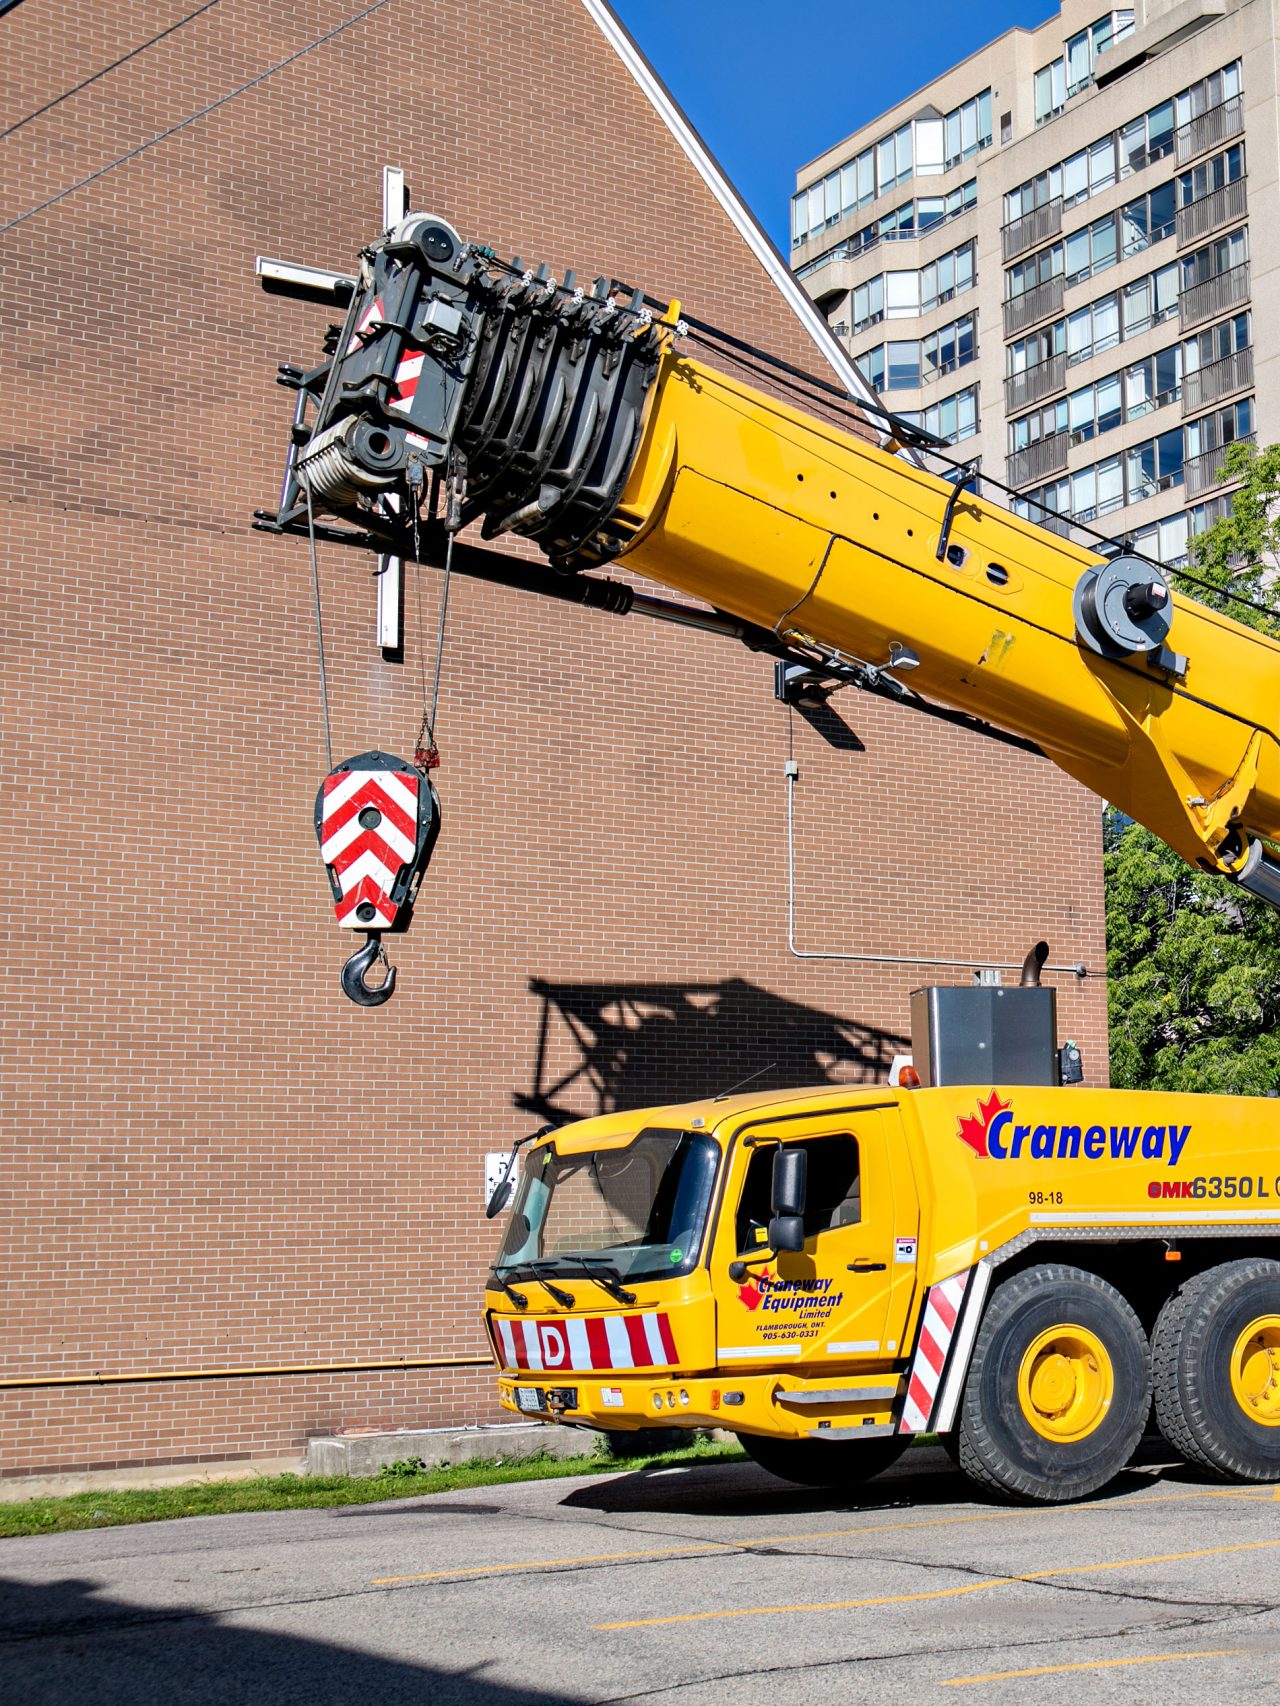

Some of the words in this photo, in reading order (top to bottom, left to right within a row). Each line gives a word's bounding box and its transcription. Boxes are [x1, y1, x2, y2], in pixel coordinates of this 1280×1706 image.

[987, 1111, 1192, 1166] Craneway
[1028, 1191, 1063, 1205] 98-18
[759, 1277, 834, 1294] Craneway
[762, 1291, 844, 1313] Equipment
[799, 1308, 832, 1320] Limited
[810, 1321, 826, 1329] ONT.
[762, 1330, 819, 1340] 905-630-0331
[540, 1326, 565, 1367] D
